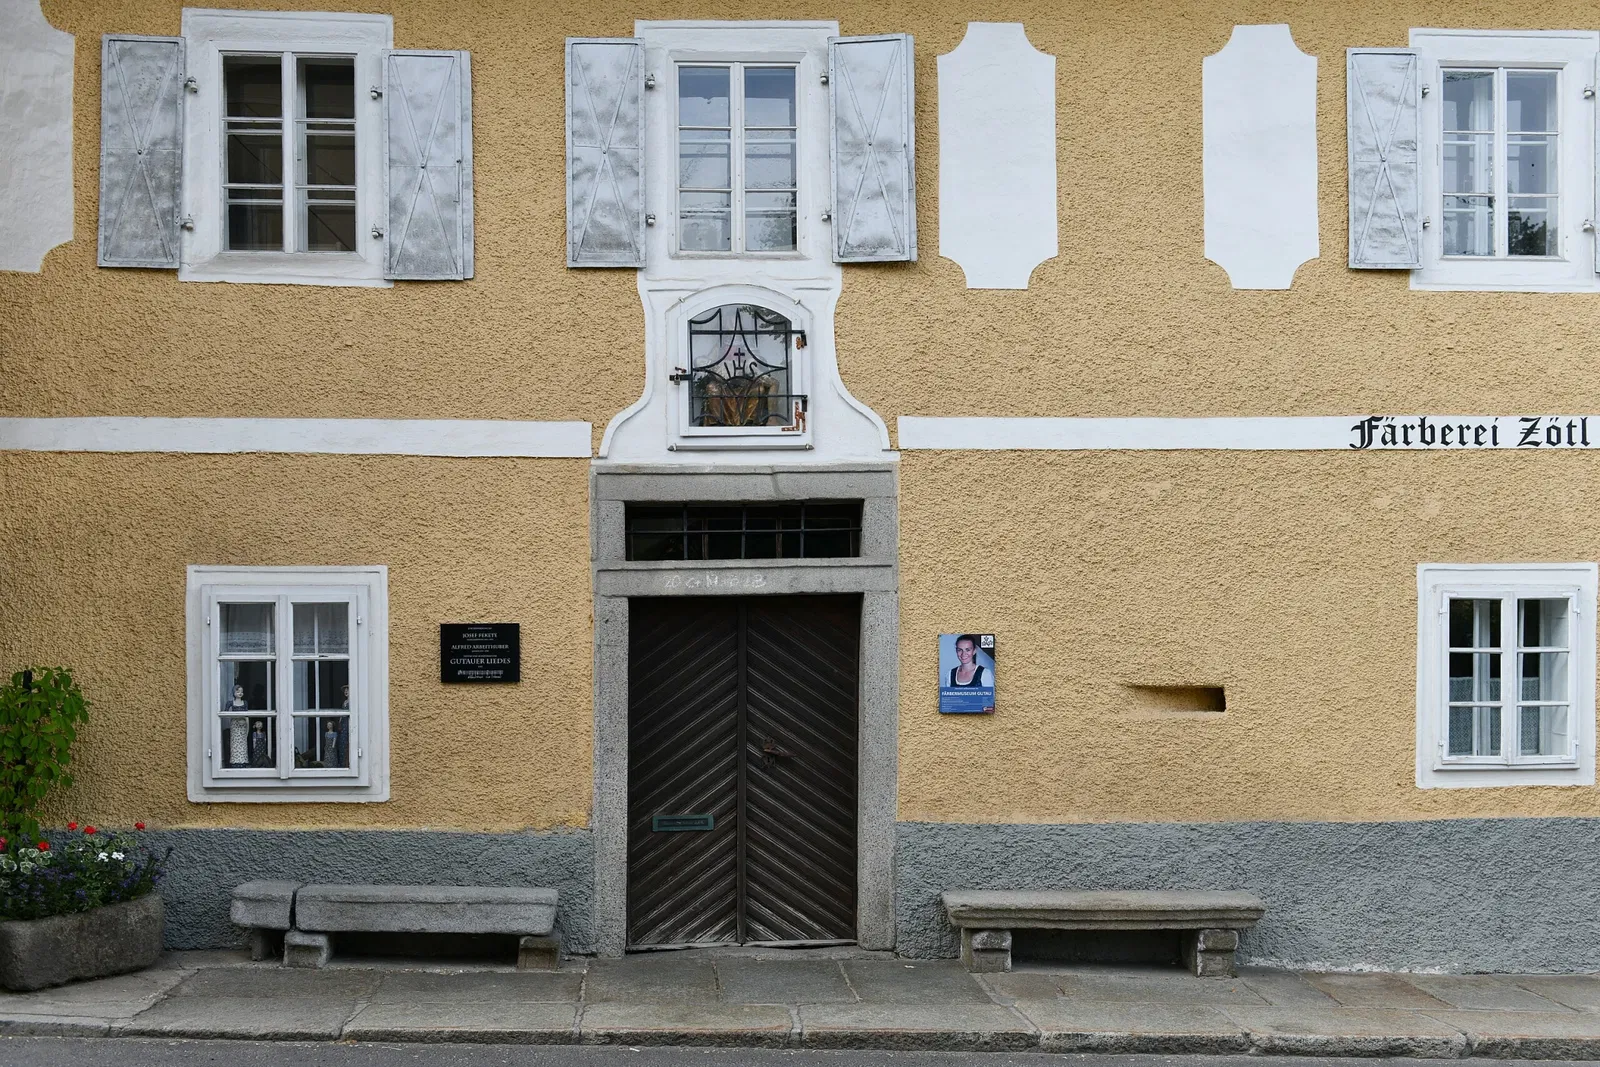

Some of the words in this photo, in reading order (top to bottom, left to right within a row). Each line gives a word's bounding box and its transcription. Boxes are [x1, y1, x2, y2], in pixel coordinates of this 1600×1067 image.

[724, 358, 758, 379] IHS
[1349, 415, 1500, 450] Färberei
[1516, 416, 1591, 448] Zötl
[486, 657, 511, 665] LIEDES
